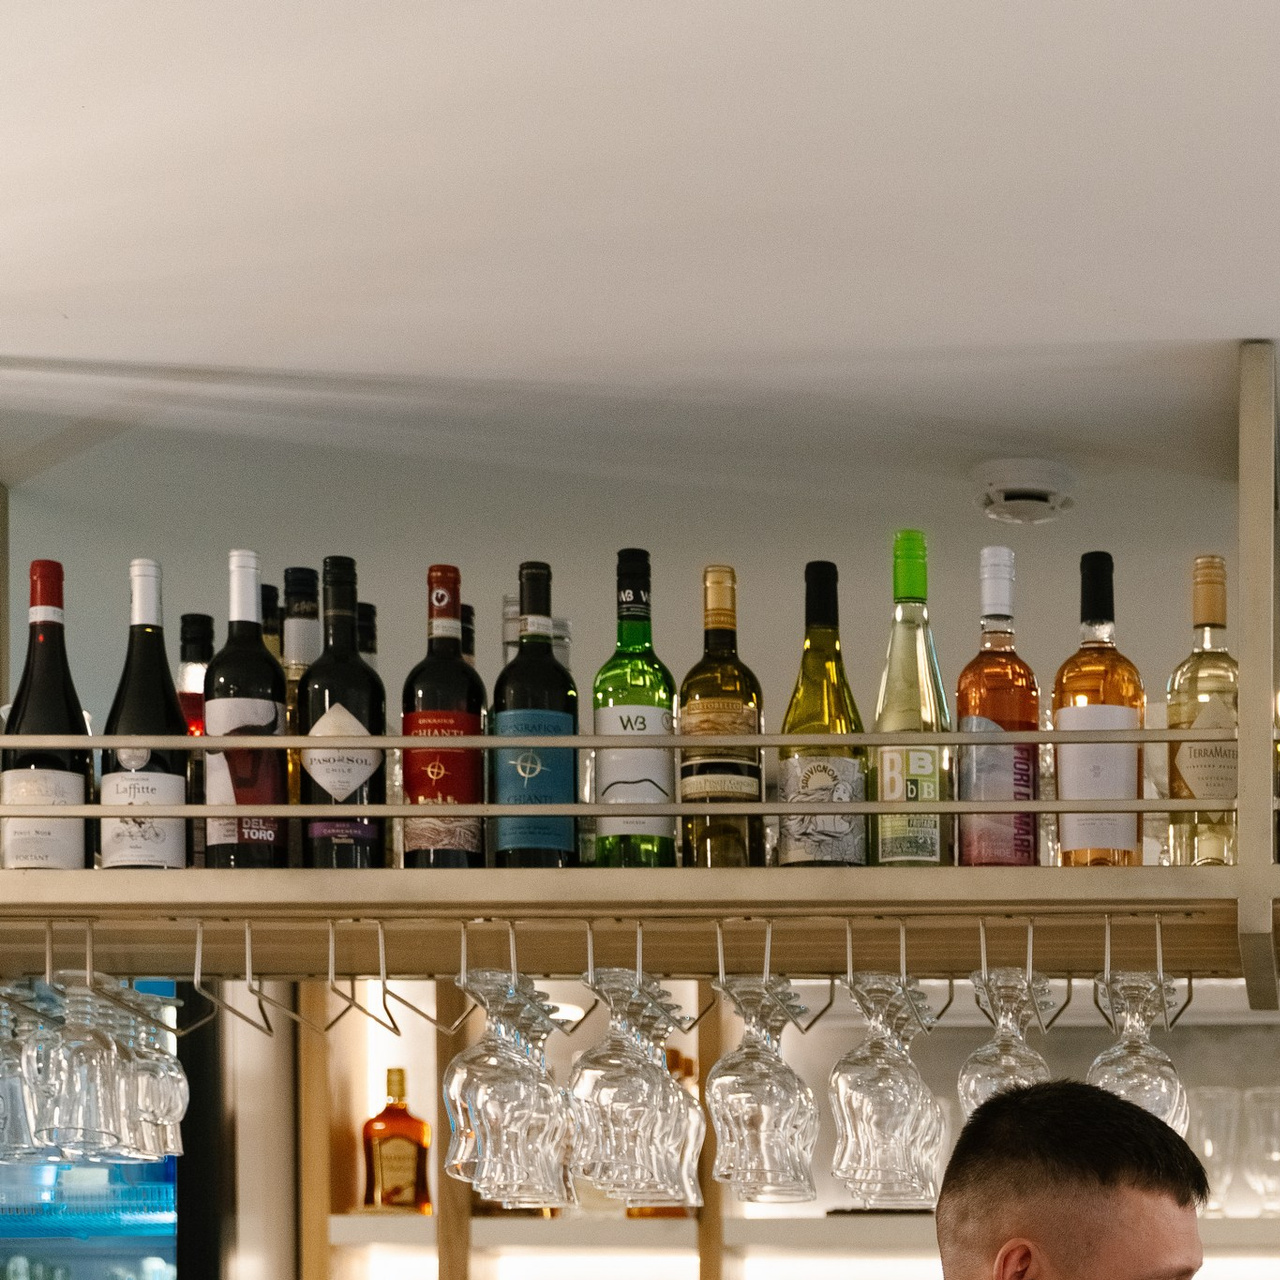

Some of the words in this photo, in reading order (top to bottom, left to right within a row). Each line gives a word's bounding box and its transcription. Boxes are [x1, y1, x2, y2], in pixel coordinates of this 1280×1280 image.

[309, 756, 336, 766] PASO
[346, 755, 371, 766] SOL
[801, 764, 839, 790] SAUVIGNON
[115, 783, 157, 799] Laffitte
[242, 817, 266, 829] DEL
[242, 828, 275, 842] TORO
